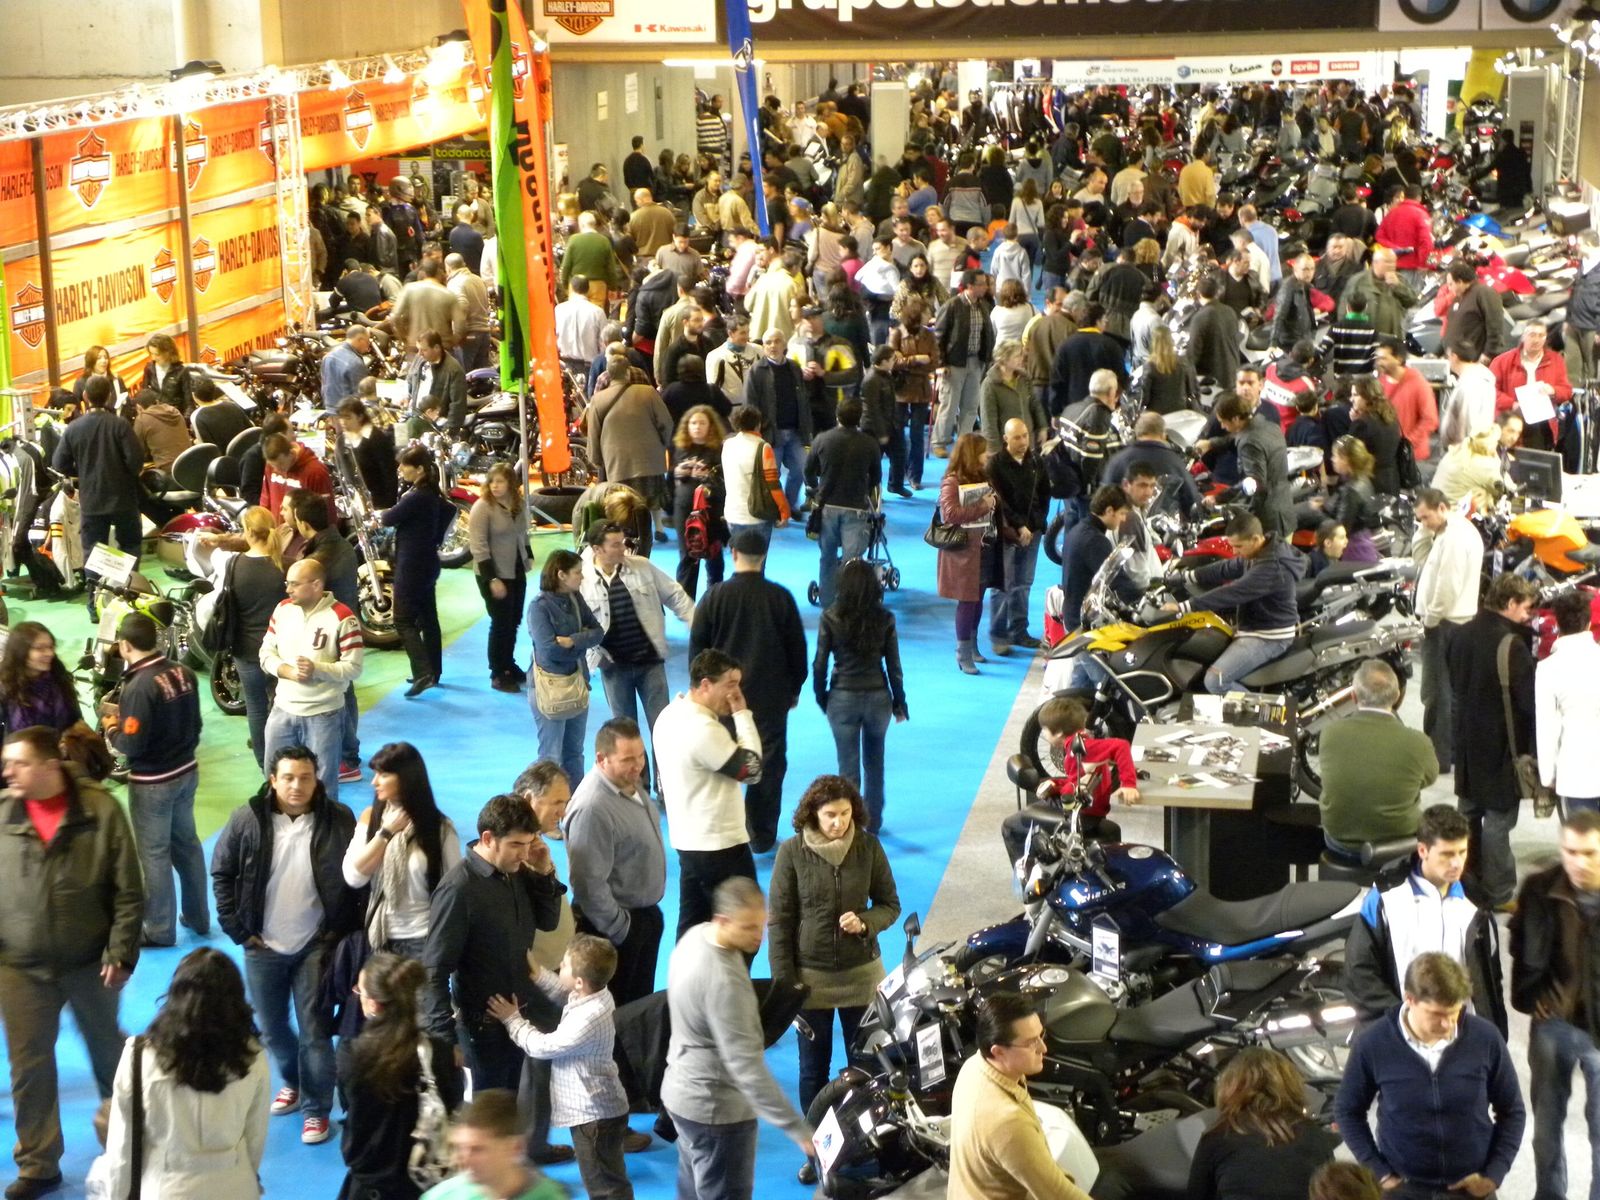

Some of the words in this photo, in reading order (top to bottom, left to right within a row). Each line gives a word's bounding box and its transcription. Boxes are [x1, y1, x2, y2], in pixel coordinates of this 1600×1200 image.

[547, 1, 611, 14] HARLEY-DAVIDSON
[562, 16, 598, 31] CYCLES
[659, 24, 706, 33] Kawasaki
[1192, 67, 1223, 75] PIAGGIO
[1293, 62, 1318, 72] aprilia
[1, 164, 63, 201] HARLEY-DDSON
[218, 224, 280, 275] HARLEY-DAVIDS
[54, 263, 146, 327] HARLEY-DAVIDSON
